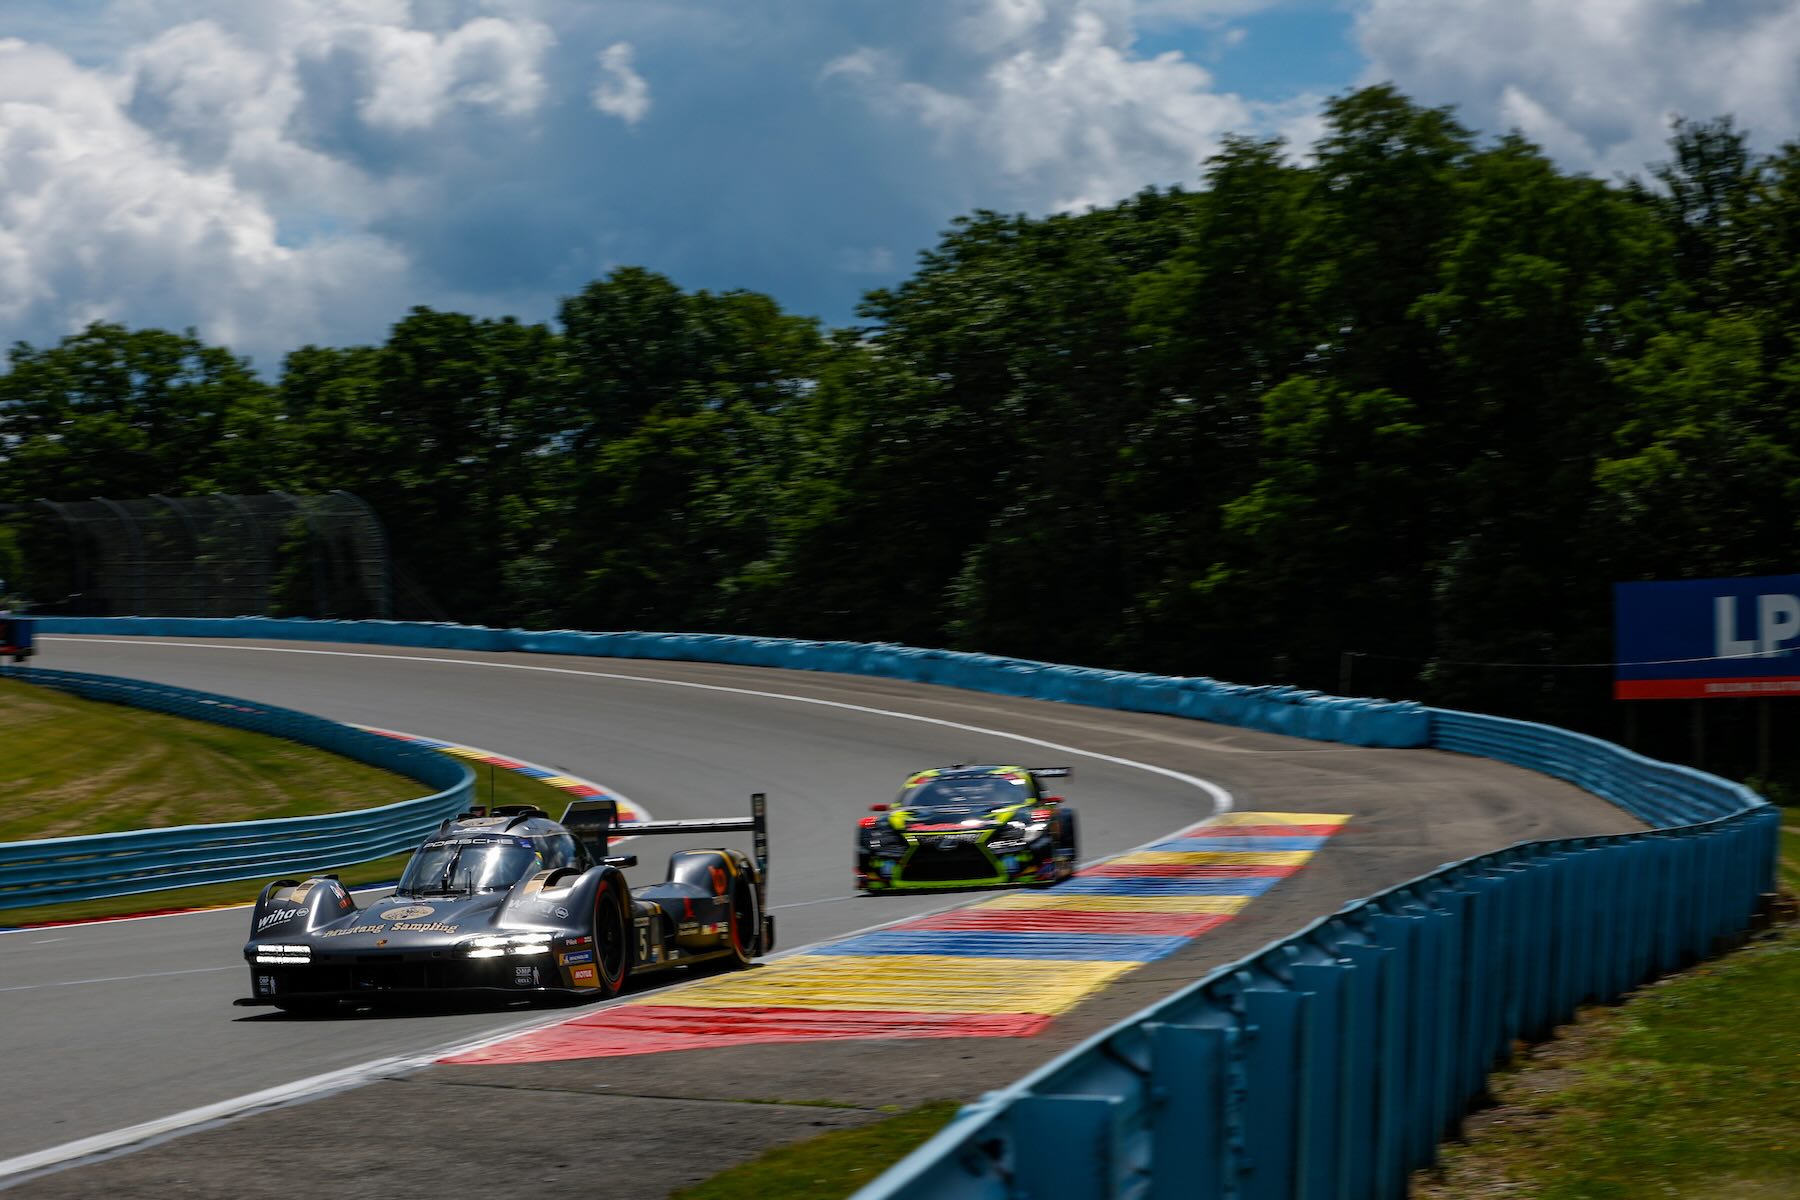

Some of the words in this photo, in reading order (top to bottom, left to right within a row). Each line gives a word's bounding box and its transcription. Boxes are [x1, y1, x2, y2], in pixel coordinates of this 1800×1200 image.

[1713, 594, 1800, 659] LP
[423, 838, 514, 849] PORSCHE
[257, 908, 297, 929] wiha
[323, 923, 387, 938] Mustang
[391, 922, 459, 934] Sampling
[639, 928, 648, 961] 5
